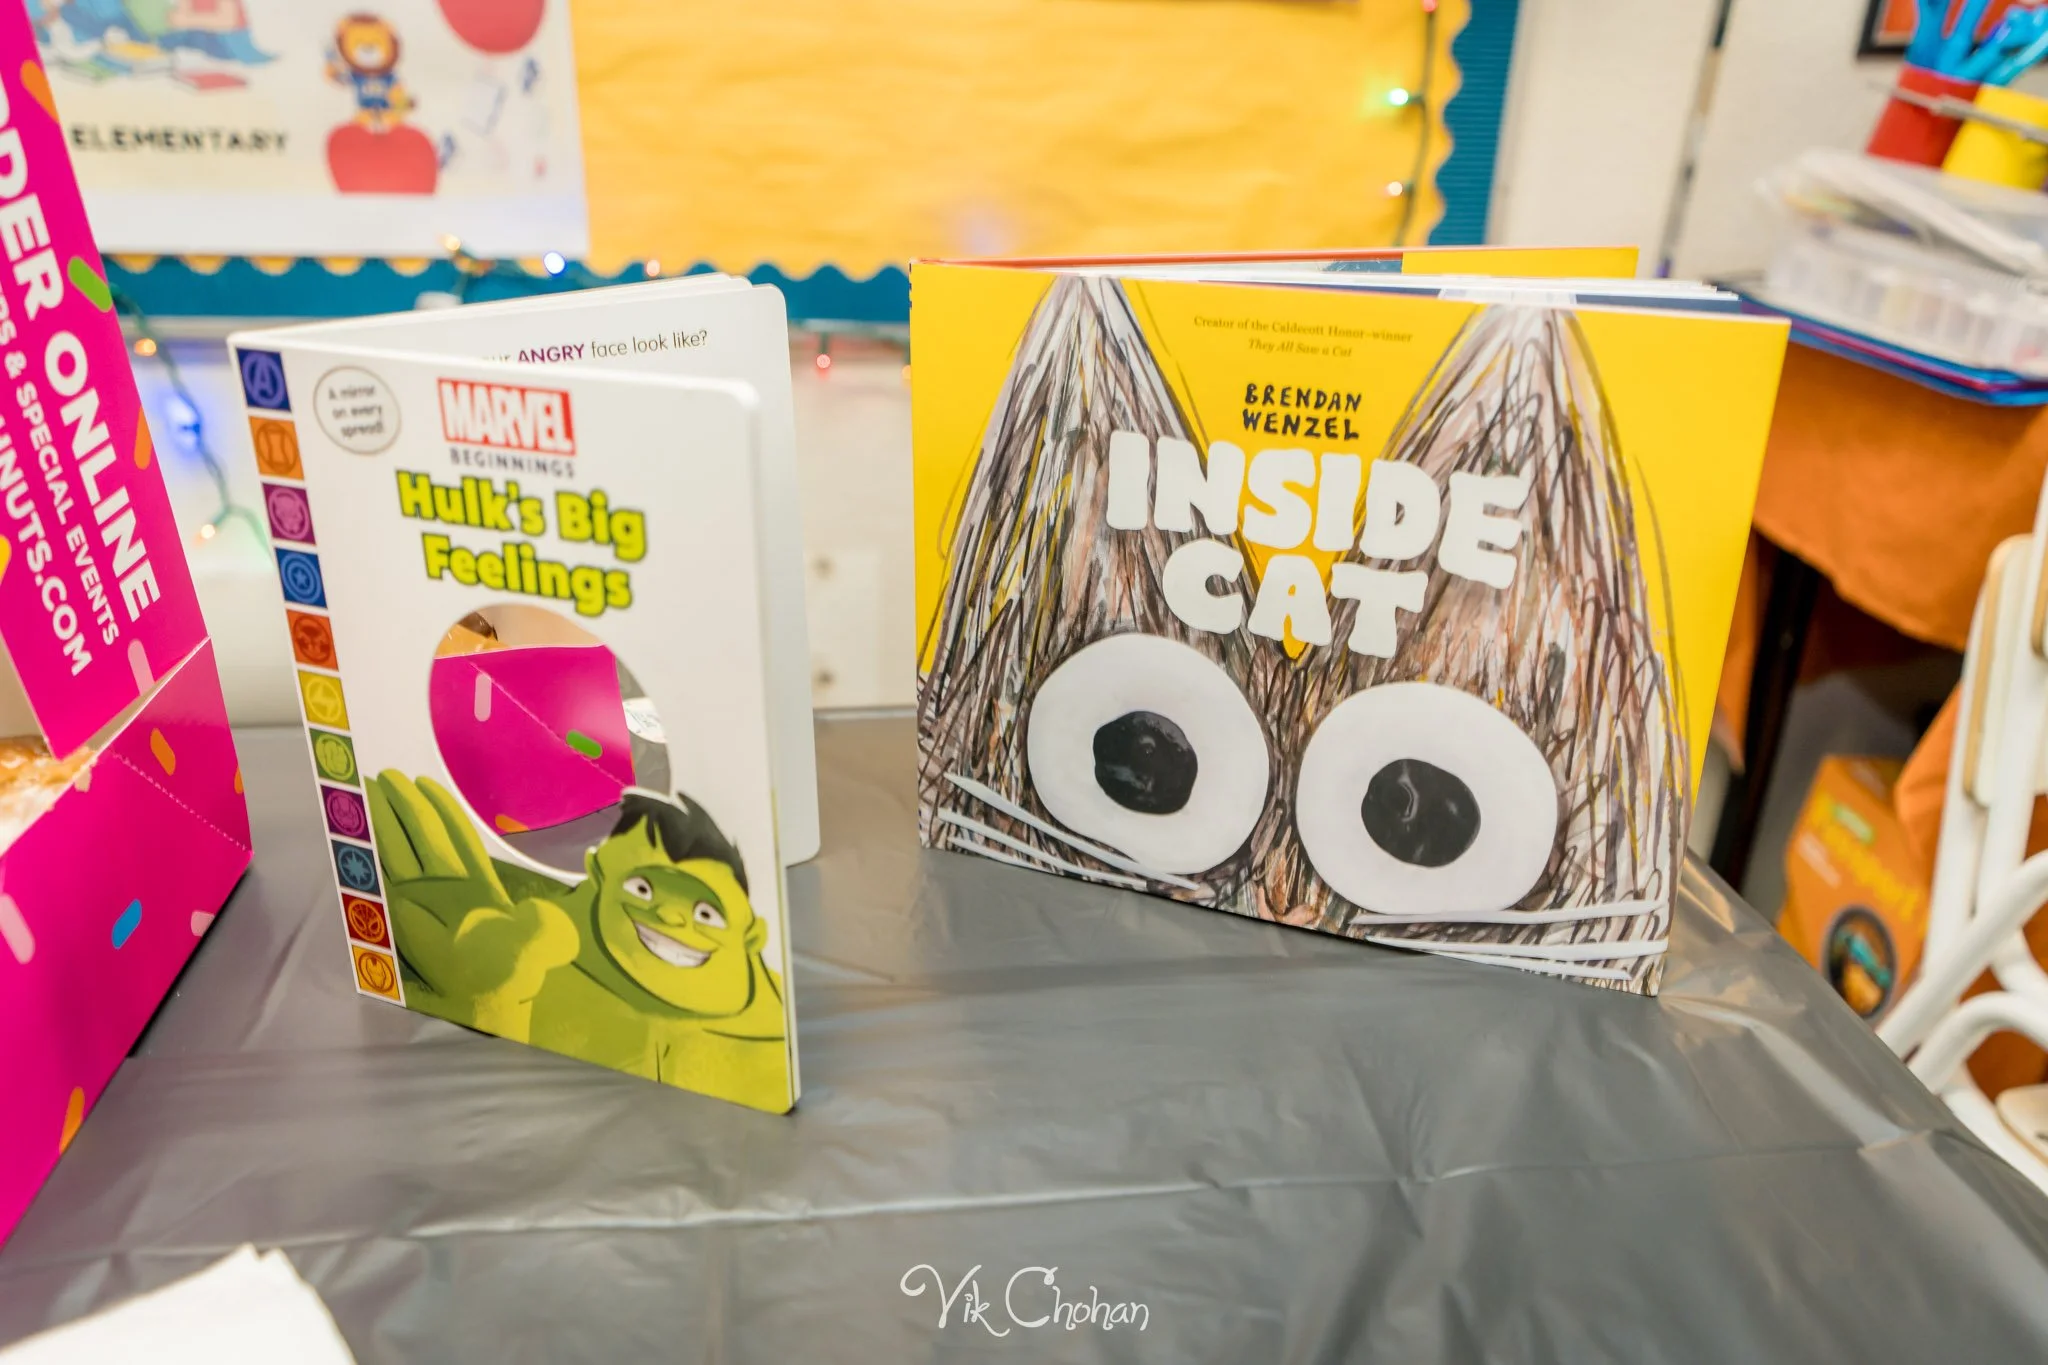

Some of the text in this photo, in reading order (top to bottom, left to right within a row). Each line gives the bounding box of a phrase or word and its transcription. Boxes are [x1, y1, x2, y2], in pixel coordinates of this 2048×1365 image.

[71, 125, 288, 152] ELEMENTARY
[0, 75, 161, 622] DER ONLINE
[518, 343, 585, 363] ANGRY
[591, 341, 628, 358] face
[632, 333, 668, 353] look
[672, 330, 708, 348] like?
[1194, 316, 1234, 330] Creator
[1237, 319, 1250, 329] of
[1251, 319, 1269, 332] the
[1272, 322, 1325, 337] Caldecott
[1248, 339, 1353, 358] They All Saw a Cat
[438, 378, 576, 456] MARVEL
[1241, 408, 1360, 441] WENZEL
[1244, 383, 1363, 413] BRENDAN
[450, 448, 575, 479] BEGINNINGS
[0, 413, 93, 677] NUTS.COM
[16, 381, 76, 525] SPECIAL
[66, 524, 119, 646] EVENTS
[396, 469, 647, 562] Hulk's Big
[1106, 430, 1528, 590] INSIDE
[421, 532, 633, 618] Feelings
[1162, 538, 1429, 659] CAT
